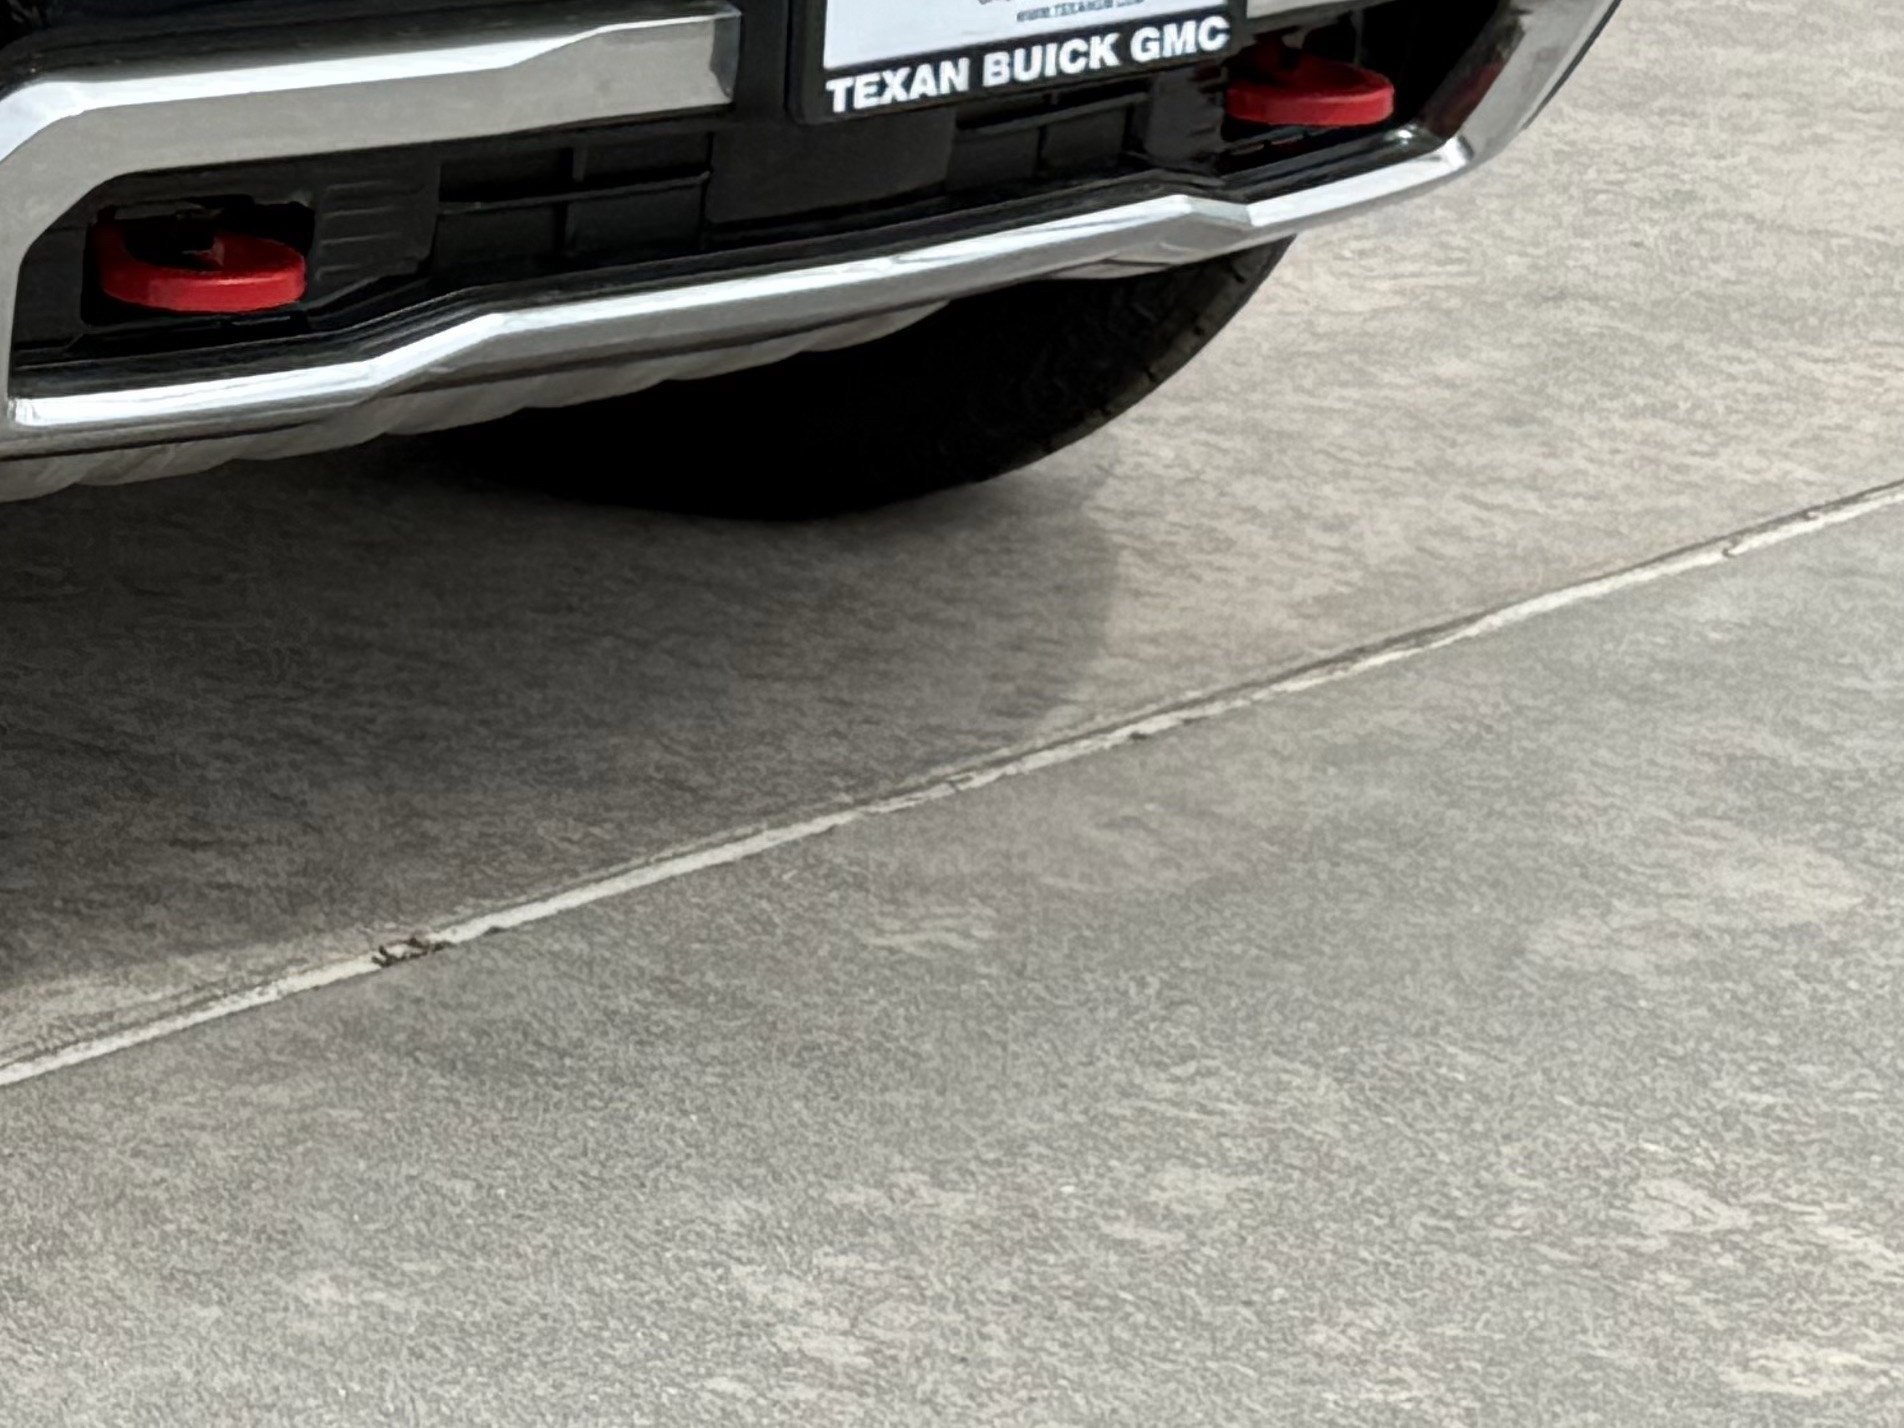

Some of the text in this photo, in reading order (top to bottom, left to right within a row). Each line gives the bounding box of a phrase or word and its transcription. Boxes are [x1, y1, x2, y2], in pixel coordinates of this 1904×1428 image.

[825, 14, 1231, 113] TEXAN BUICK GMC
